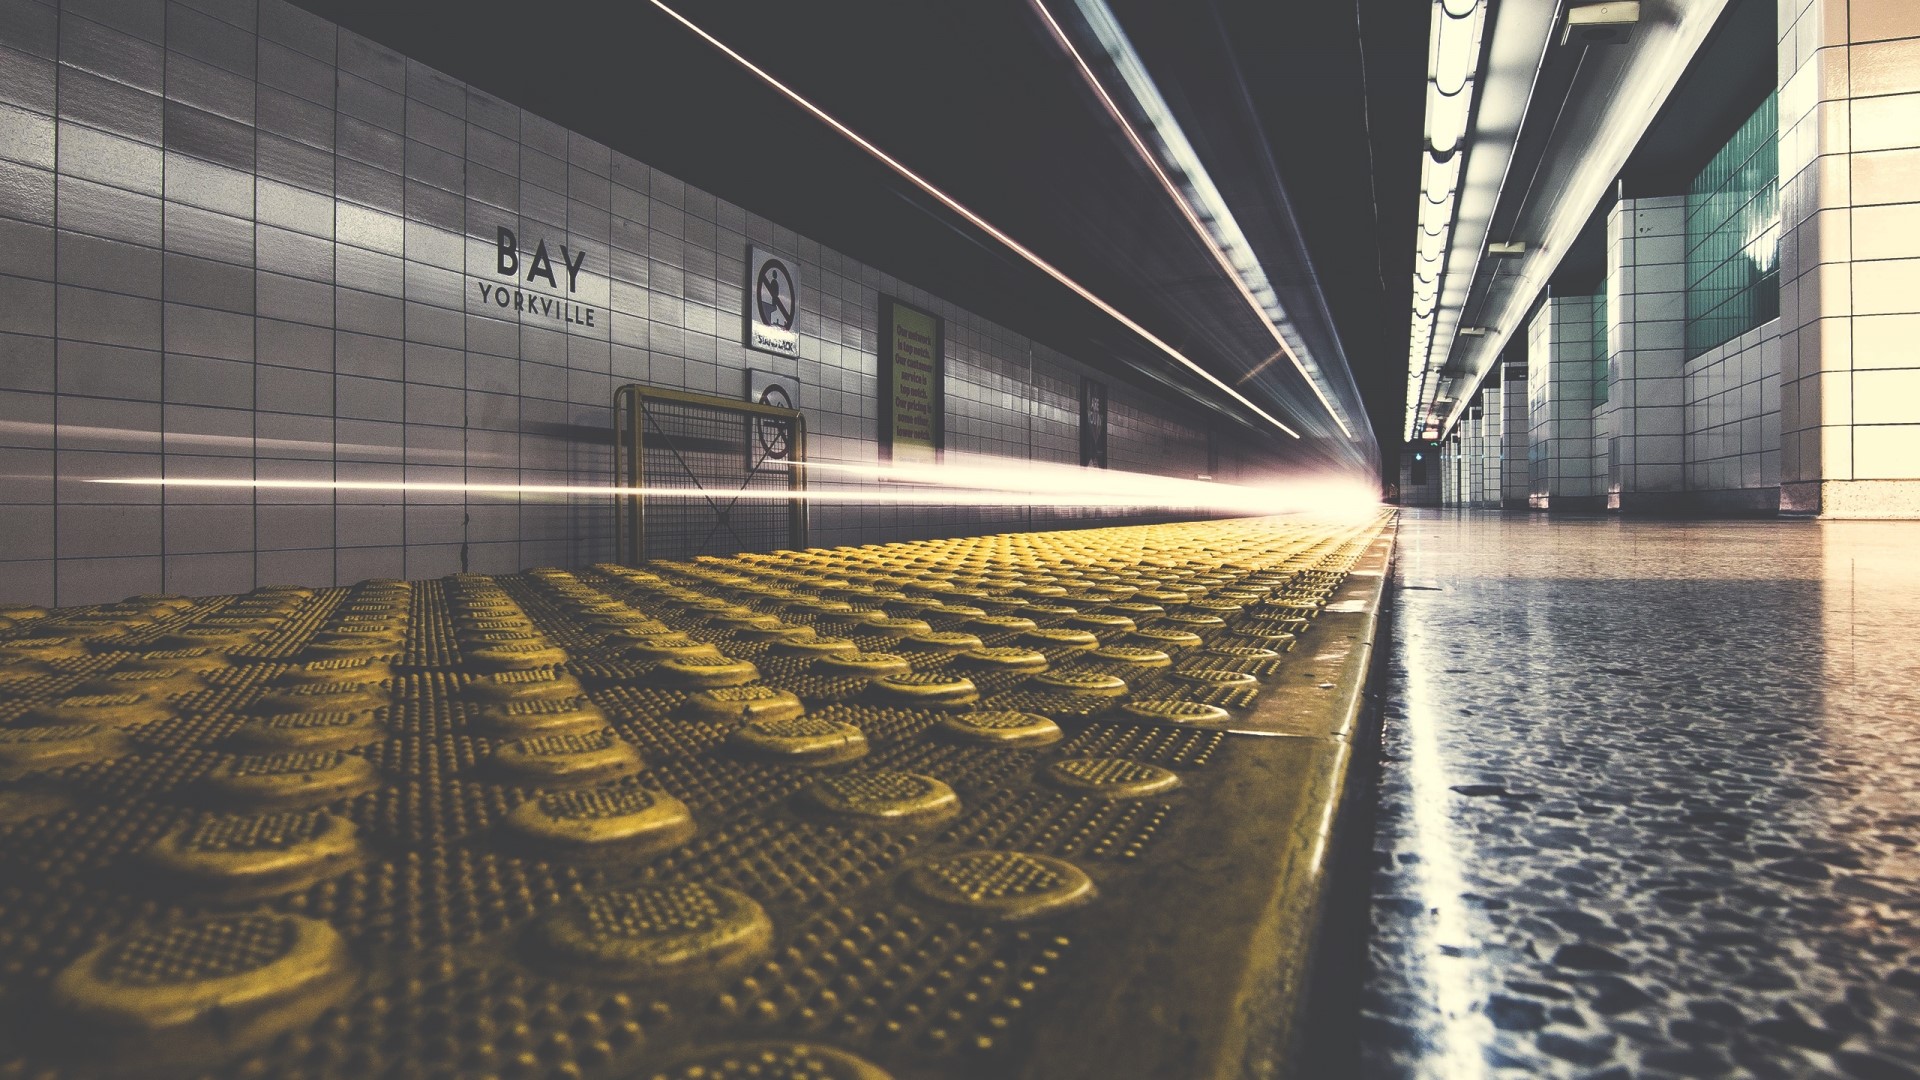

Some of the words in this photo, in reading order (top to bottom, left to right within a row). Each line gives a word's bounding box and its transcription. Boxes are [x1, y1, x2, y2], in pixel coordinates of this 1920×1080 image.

[497, 226, 585, 293] BAY
[478, 282, 595, 327] YORKVILLE
[897, 324, 908, 338] Our
[908, 330, 931, 346] network
[903, 341, 914, 355] top
[896, 353, 906, 366] Our
[907, 359, 932, 373] customer
[902, 372, 922, 384] service
[922, 374, 928, 385] is
[901, 384, 910, 397] top
[896, 396, 907, 408] Our
[907, 400, 927, 415] pricing
[898, 414, 913, 424] some
[897, 426, 913, 438] lower
